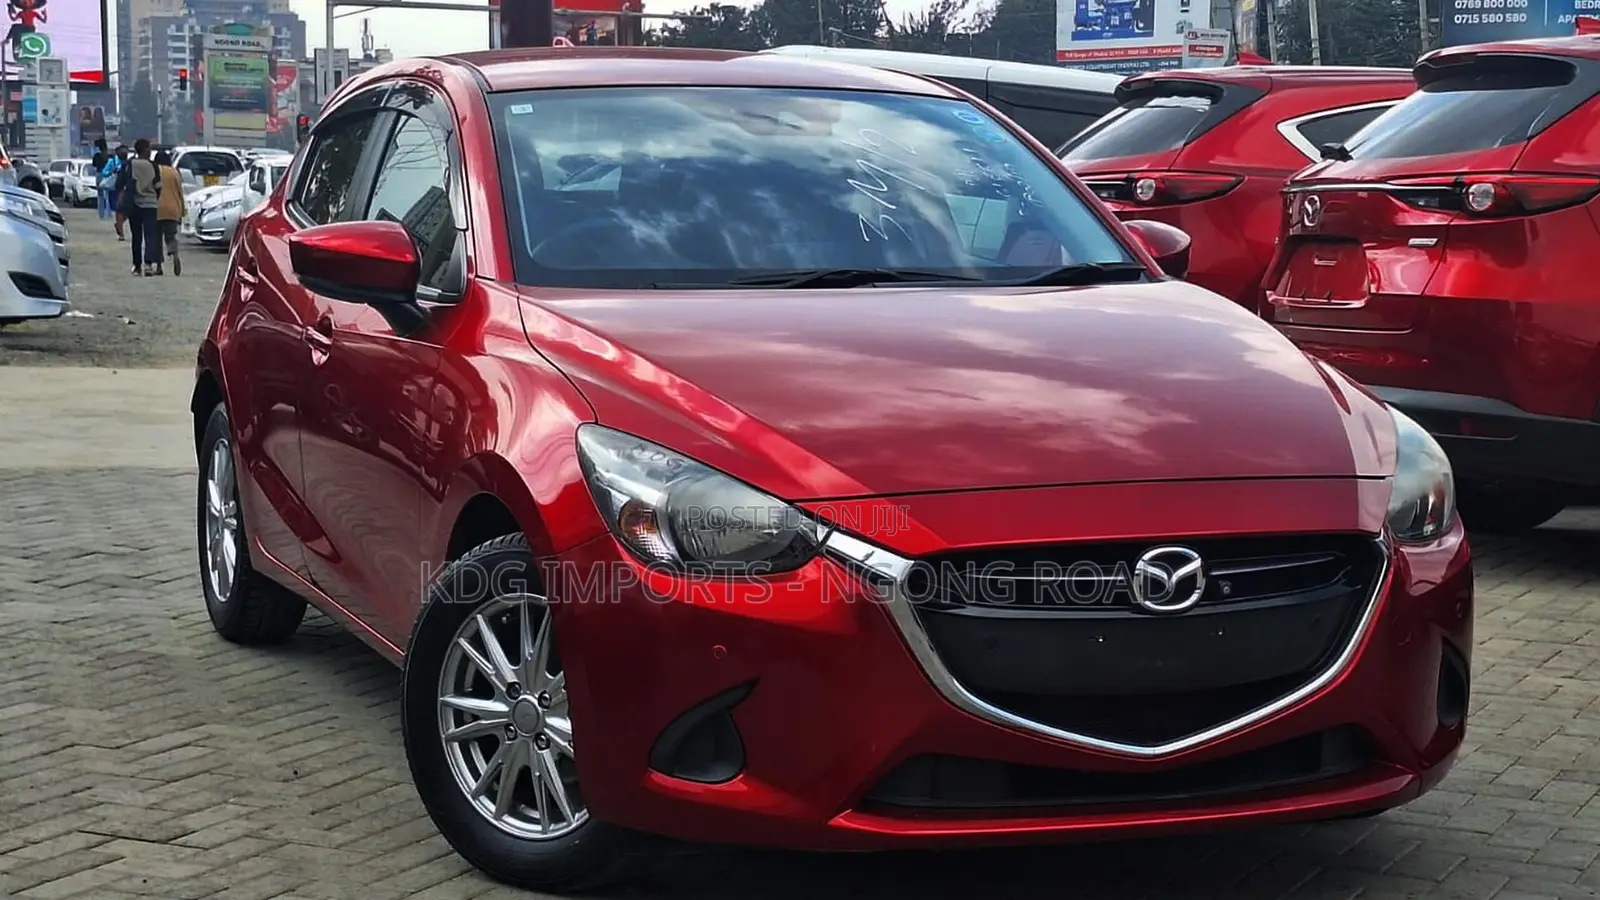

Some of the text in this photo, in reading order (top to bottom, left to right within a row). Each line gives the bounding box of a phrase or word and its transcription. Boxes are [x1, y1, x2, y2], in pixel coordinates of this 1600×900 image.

[1507, 0, 1528, 8] 000
[1454, 14, 1480, 24] 0715
[1482, 14, 1504, 23] 580
